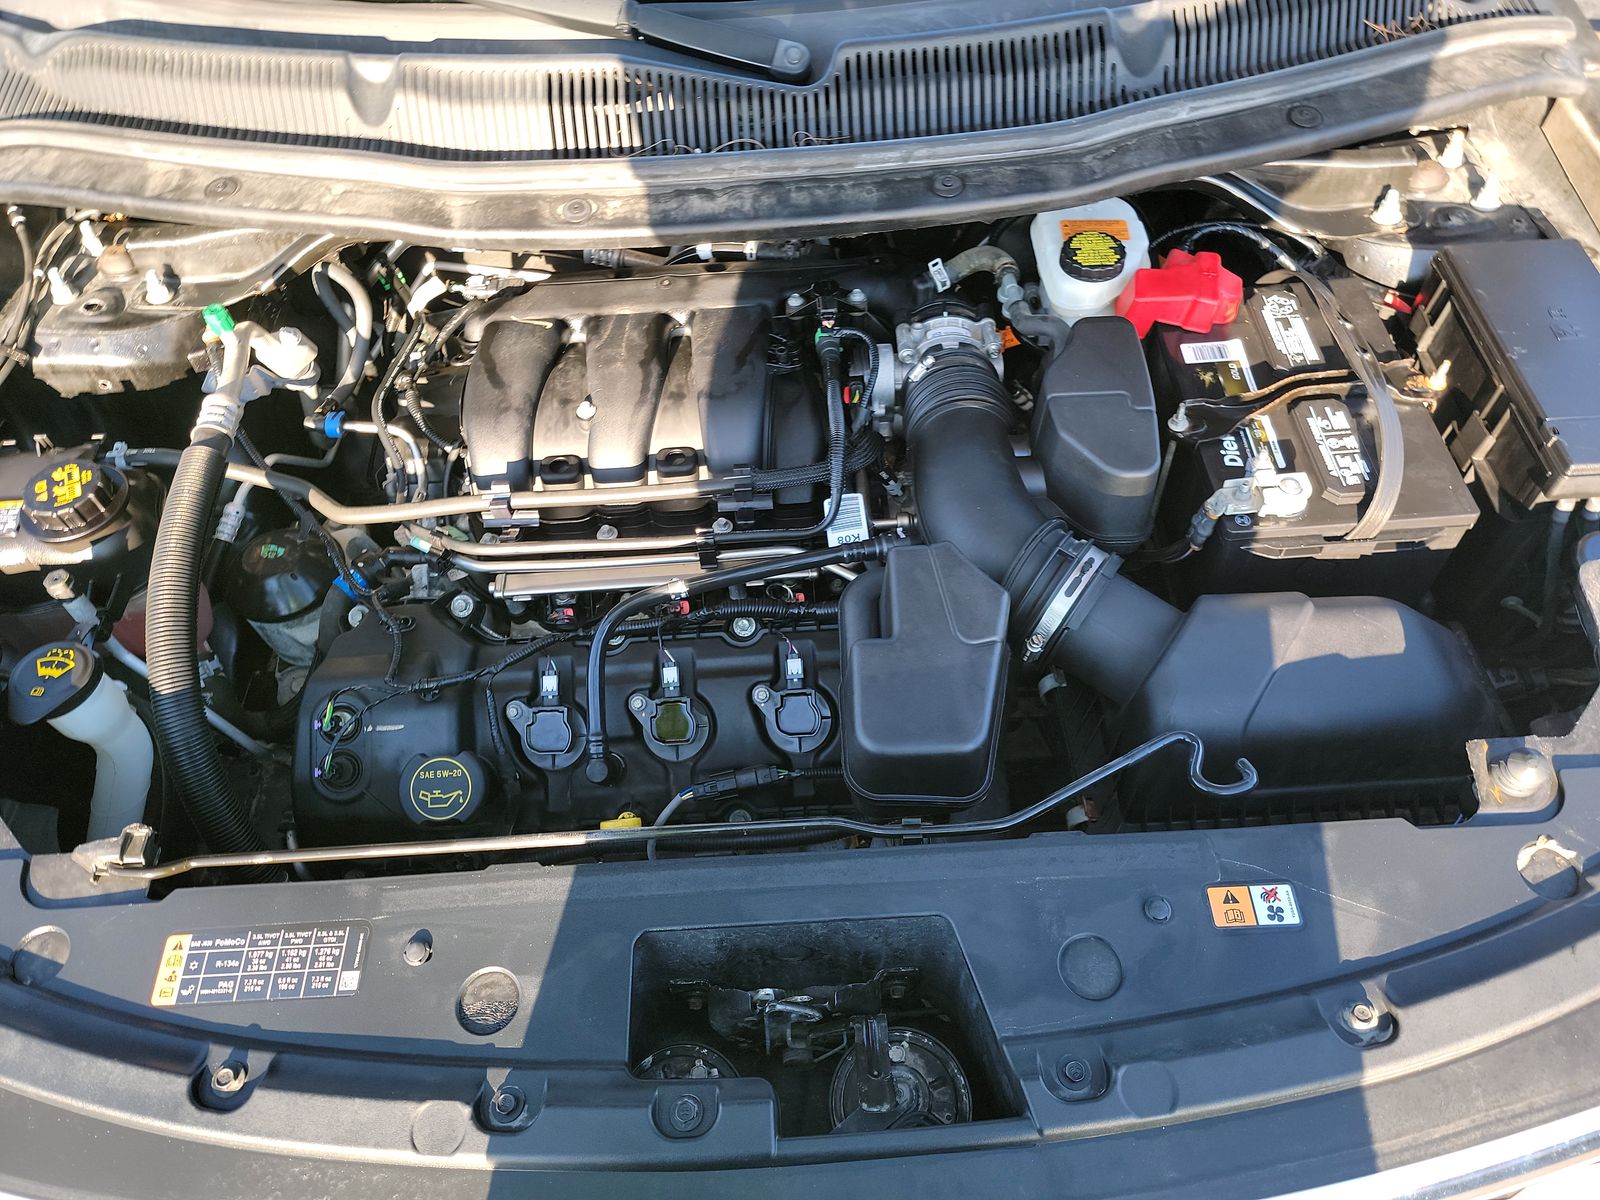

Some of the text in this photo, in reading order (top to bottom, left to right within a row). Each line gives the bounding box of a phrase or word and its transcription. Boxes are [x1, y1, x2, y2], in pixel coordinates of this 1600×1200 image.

[1231, 363, 1241, 380] GOLD
[837, 533, 861, 544] K08
[419, 769, 462, 779] SAE 5W-20
[215, 938, 245, 947] FoMoCo
[216, 960, 239, 968] R-134a
